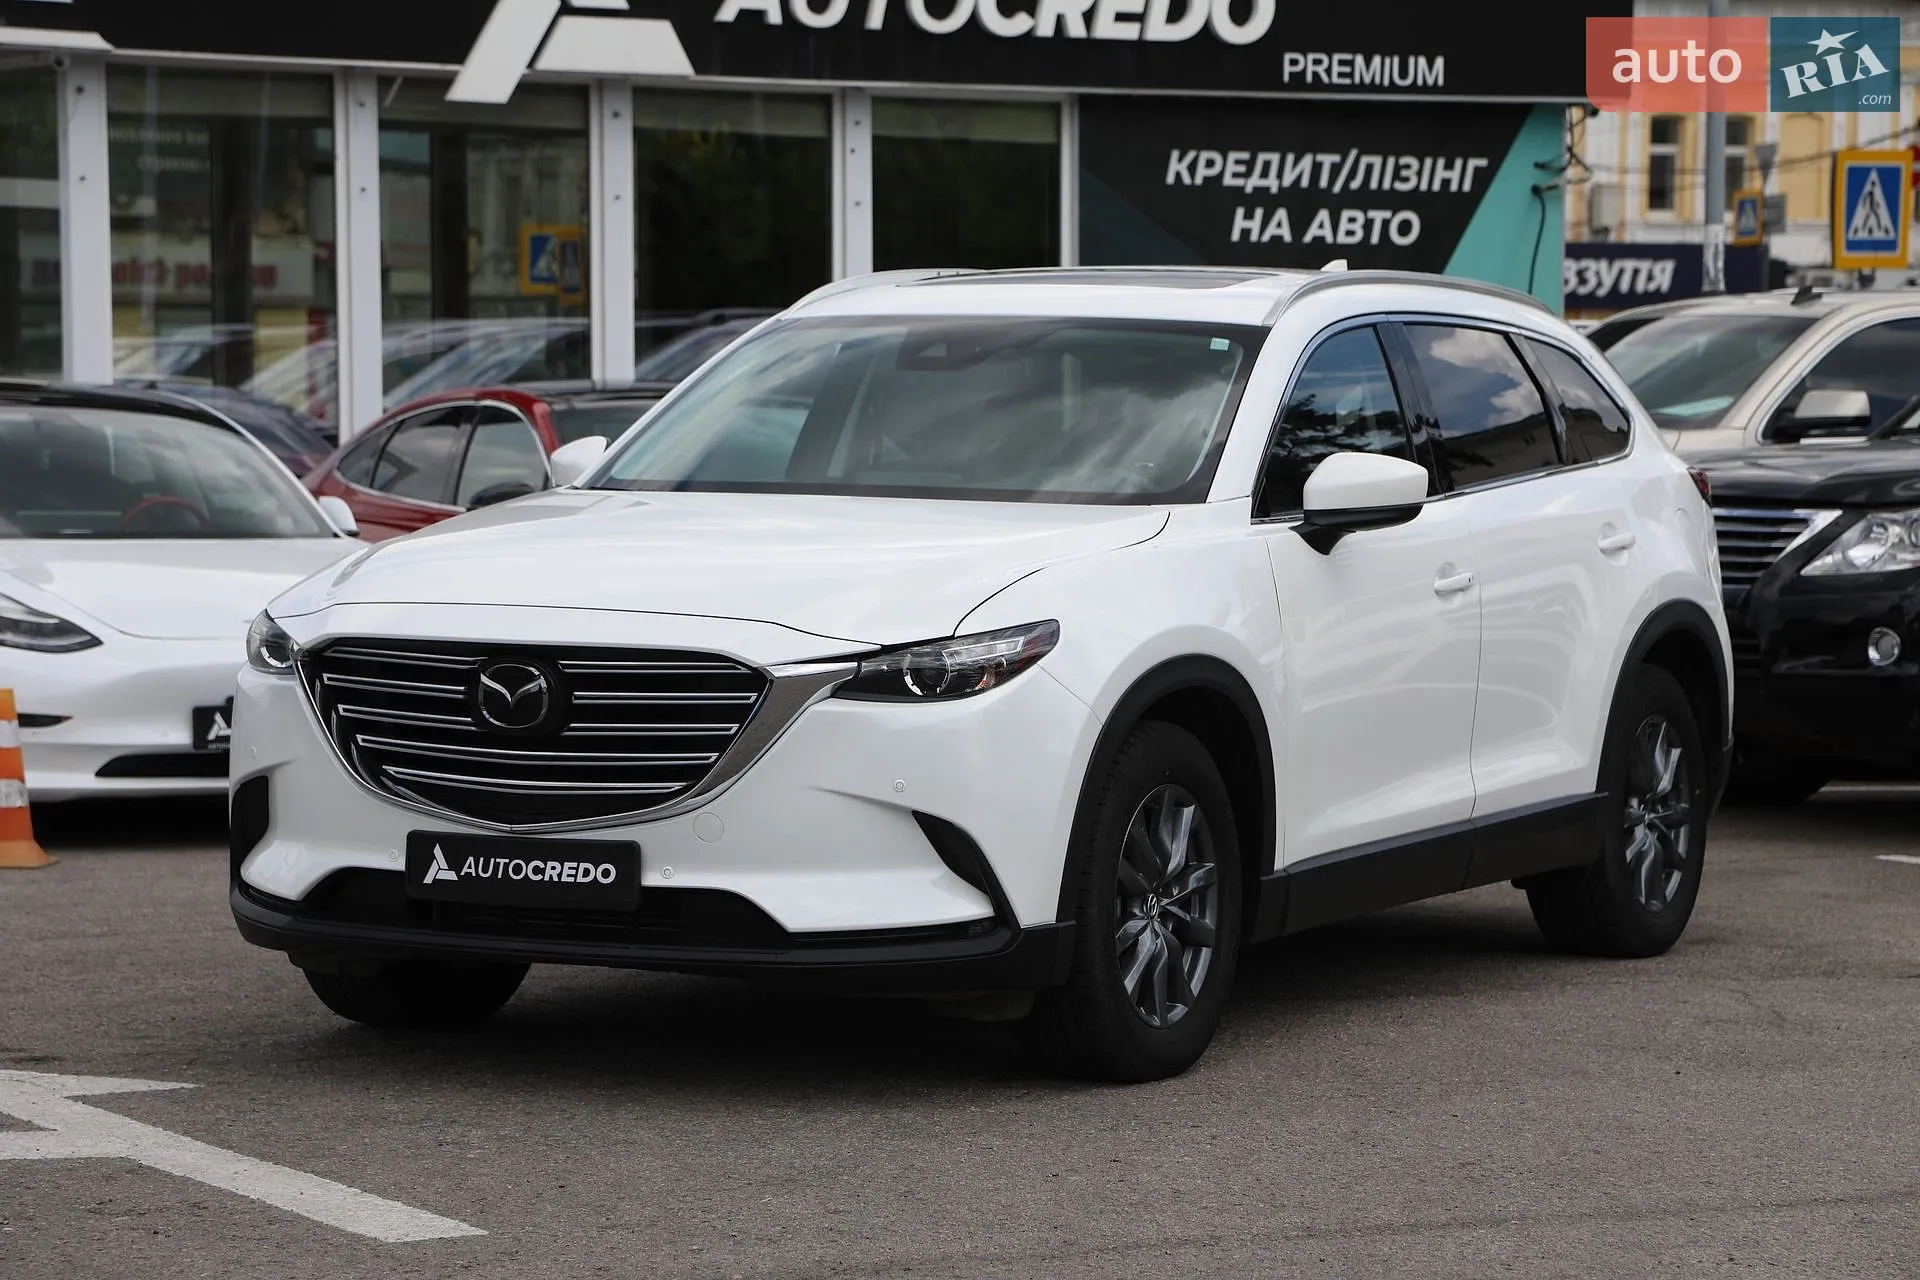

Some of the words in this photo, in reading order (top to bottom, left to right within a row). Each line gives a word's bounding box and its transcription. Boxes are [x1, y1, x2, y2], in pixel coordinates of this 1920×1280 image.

[1282, 52, 1445, 87] PREMIUM
[1165, 148, 1488, 194] КРЕДИТ/ЛІЗІНГ
[1230, 206, 1293, 243] НА
[1302, 208, 1422, 246] АВТО
[460, 856, 617, 884] AUTOCREDO
